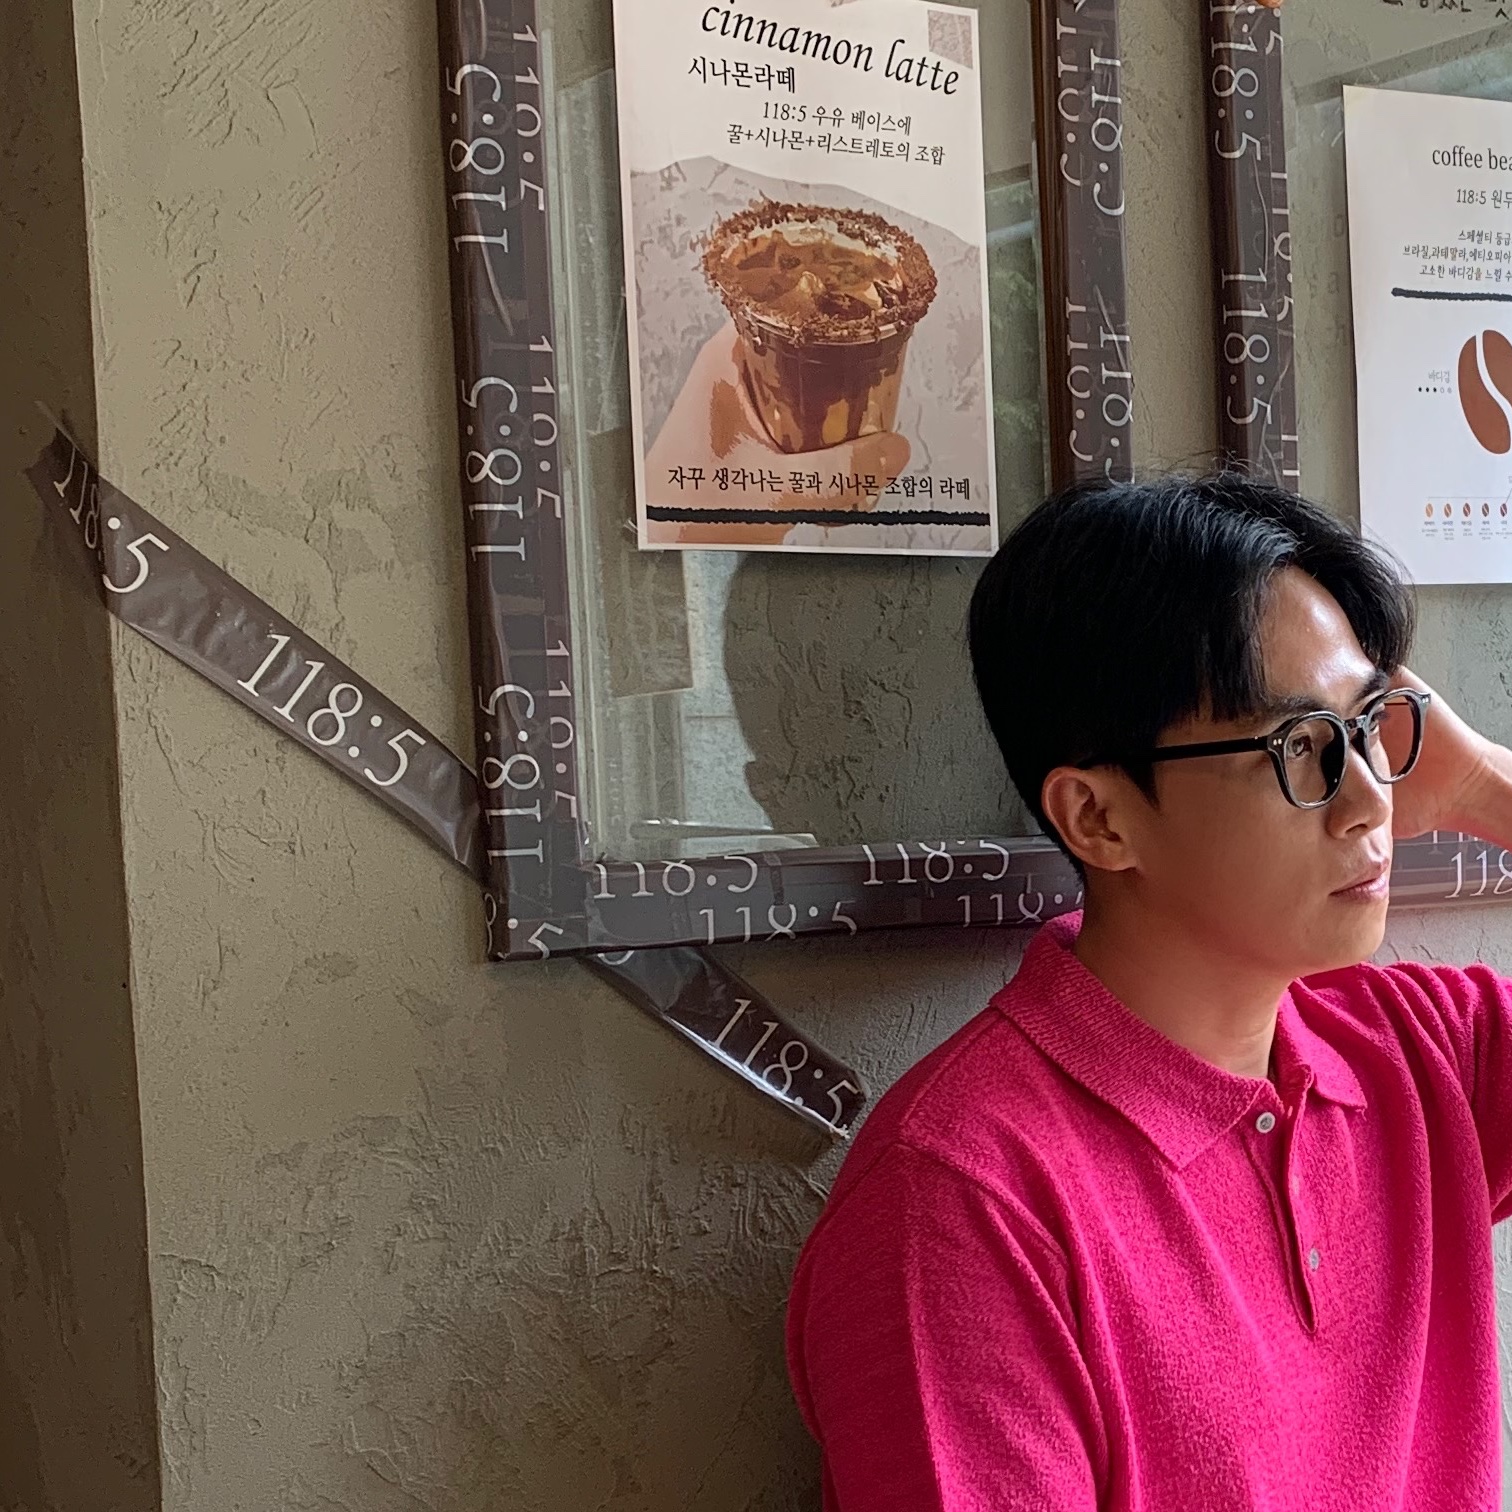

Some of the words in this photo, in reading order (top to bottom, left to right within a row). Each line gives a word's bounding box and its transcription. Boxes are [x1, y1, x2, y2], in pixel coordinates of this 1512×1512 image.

[702, 0, 873, 72] cinnamon
[884, 39, 960, 95] latte
[688, 56, 796, 93] 시나몬라떼
[763, 101, 807, 122] 118:5
[812, 106, 845, 127] 우유
[851, 110, 912, 136] 베이스에
[727, 123, 911, 163] 꿀+시나몬+리스트레토의
[914, 145, 946, 166] 조합
[1432, 145, 1483, 168] coffee
[1456, 188, 1487, 205] 118:5
[668, 465, 706, 491] 자꾸
[711, 467, 784, 493] 생각나는
[788, 472, 823, 494] 꿀과
[828, 473, 879, 496] 시나몬
[885, 475, 933, 498] 조합의
[939, 477, 971, 500] 라떼
[237, 633, 427, 787] 118:5
